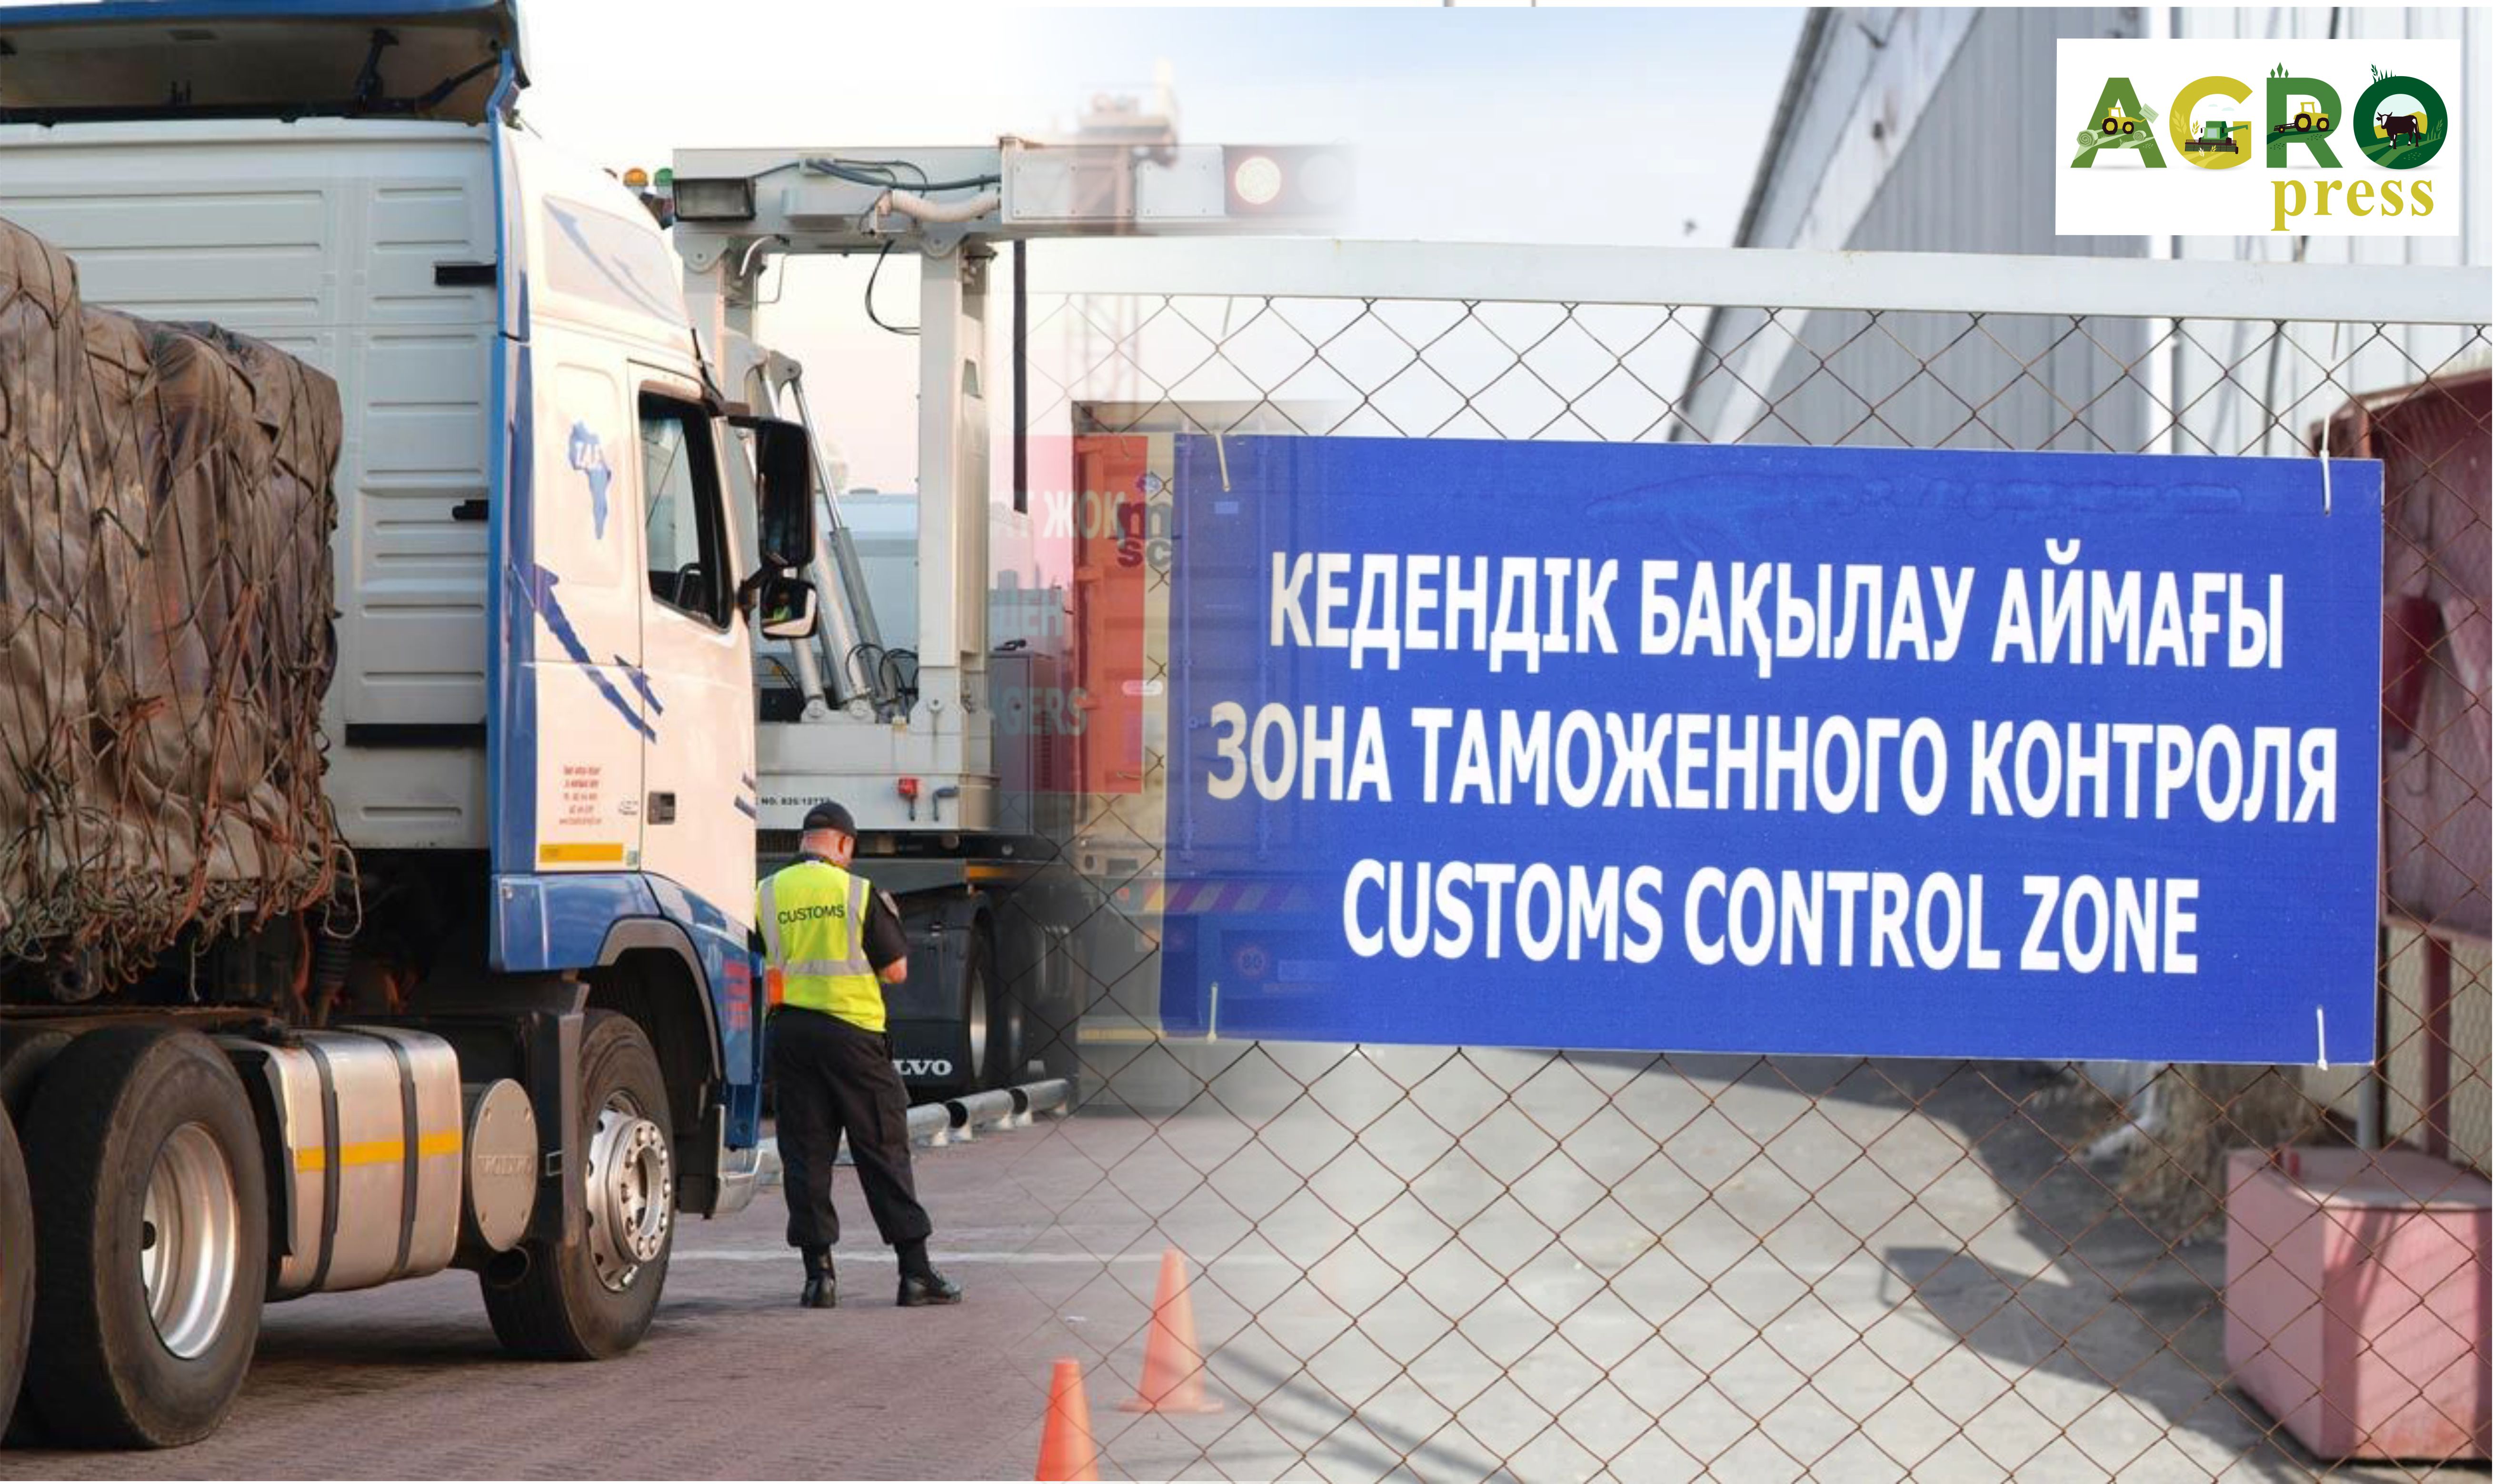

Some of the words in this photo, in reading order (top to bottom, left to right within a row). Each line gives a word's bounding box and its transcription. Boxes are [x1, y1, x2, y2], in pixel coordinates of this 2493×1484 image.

[1270, 551, 1619, 674] КЕДЕНДІК
[1640, 559, 1975, 679] БАҚЫЛАУ
[1991, 538, 2284, 669] АЙМАҒЫ
[1207, 700, 1392, 802] ЗОНА
[1411, 707, 1948, 816] ТАМОЖЕННОГО
[1970, 719, 2337, 824] КОНТРОЛЯ
[778, 905, 845, 925] CUSTOMS
[1343, 858, 1664, 964] CUSTOMS
[1684, 866, 2001, 971] CONTROL
[2020, 874, 2200, 974] ZONE
